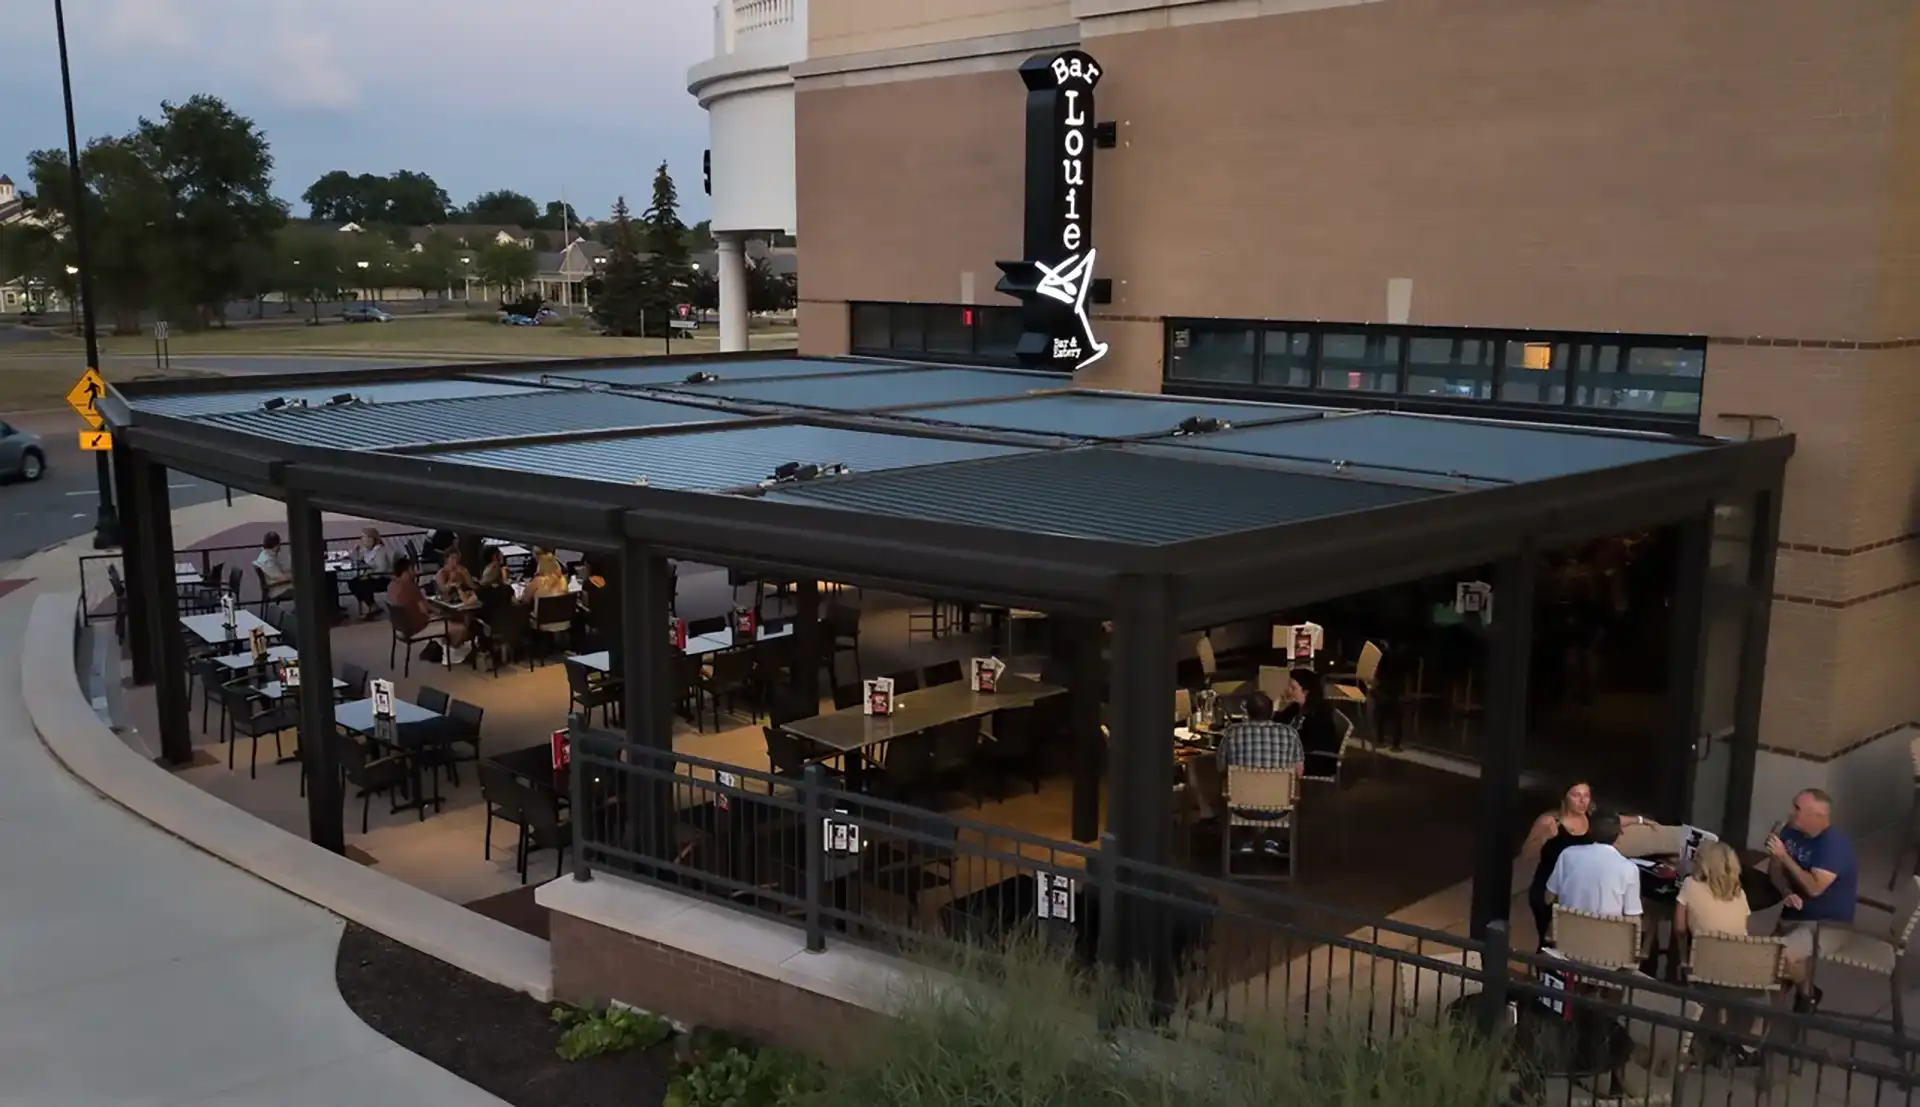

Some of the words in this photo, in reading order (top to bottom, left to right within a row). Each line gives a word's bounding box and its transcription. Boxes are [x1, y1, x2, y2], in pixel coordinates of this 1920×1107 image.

[1051, 57, 1099, 84] Bar
[1063, 90, 1085, 250] Louie
[1053, 338, 1069, 349] Bar
